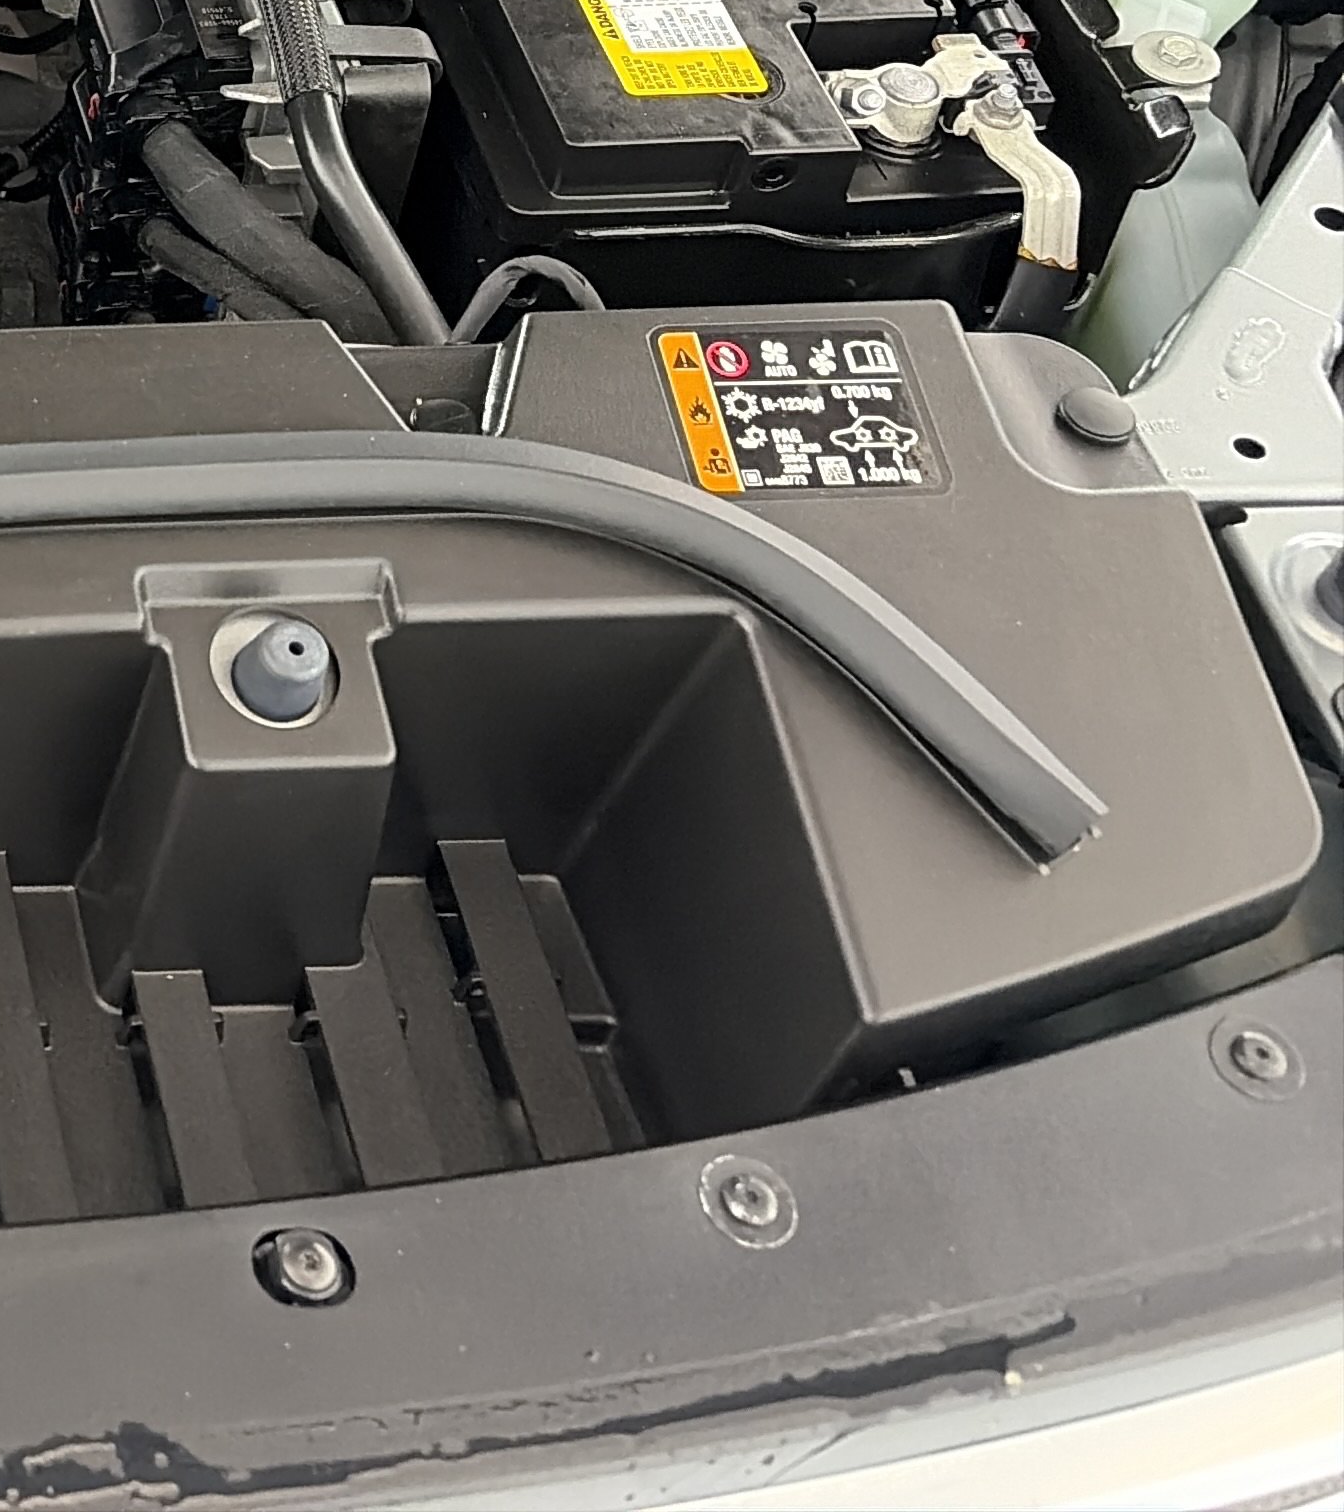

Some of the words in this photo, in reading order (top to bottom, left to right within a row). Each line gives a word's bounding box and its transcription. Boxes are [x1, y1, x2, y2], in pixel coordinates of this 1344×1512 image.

[765, 364, 797, 377] AUTO
[872, 385, 892, 401] kg
[762, 396, 825, 414] R-1234yf
[771, 428, 803, 443] PAG
[900, 468, 921, 483] kg
